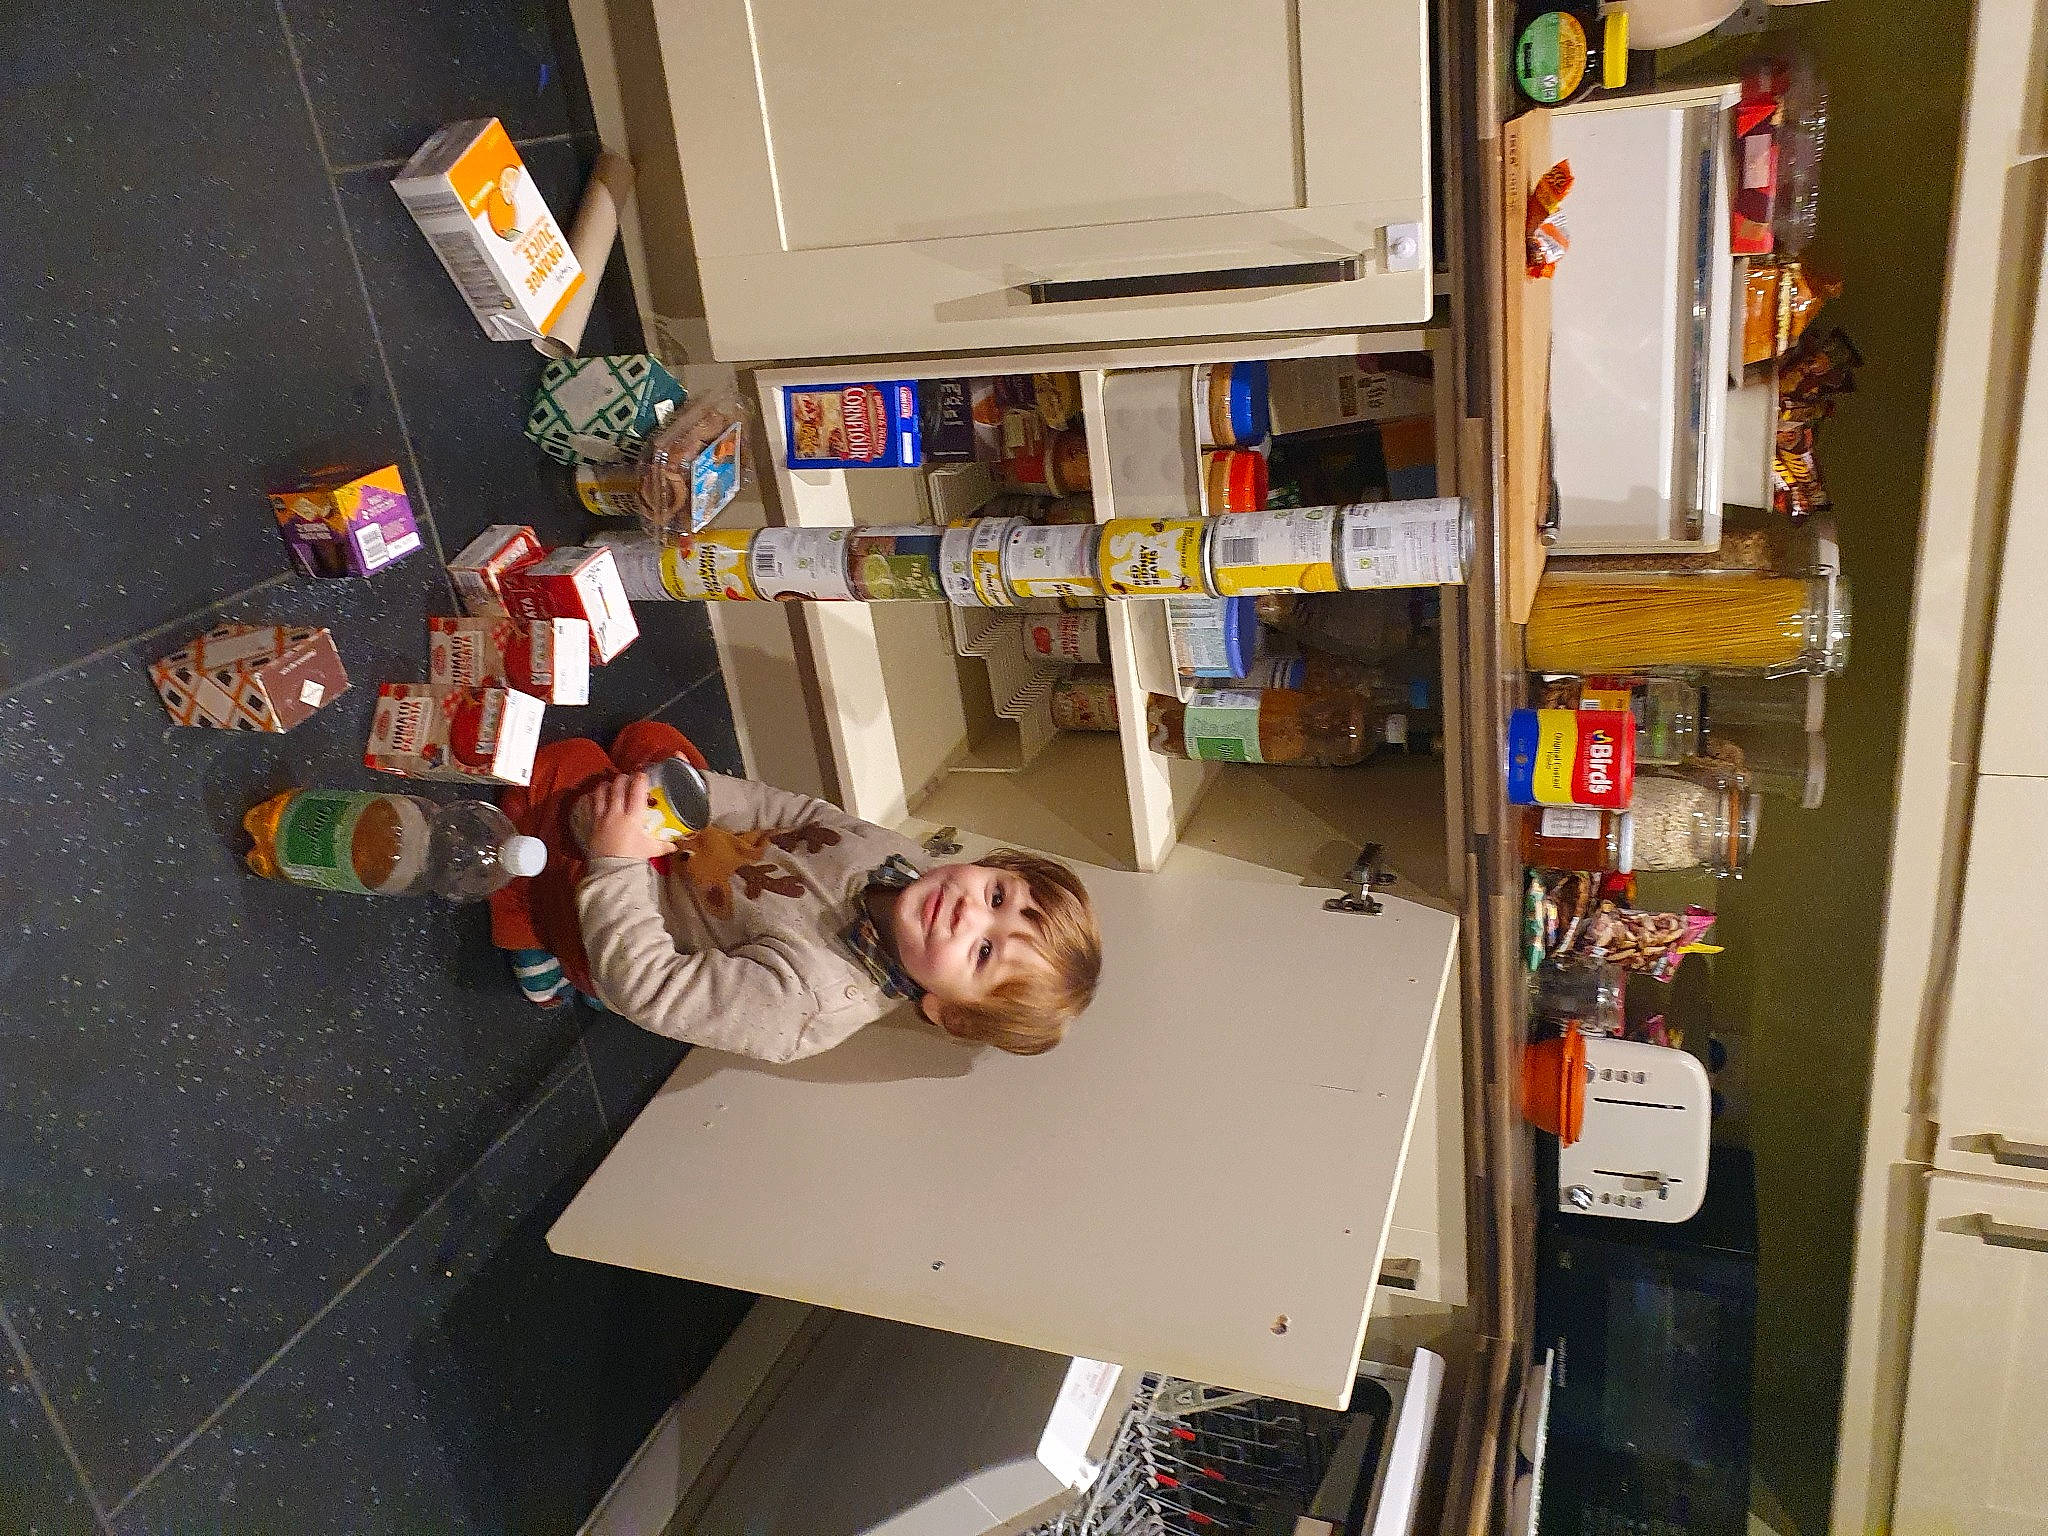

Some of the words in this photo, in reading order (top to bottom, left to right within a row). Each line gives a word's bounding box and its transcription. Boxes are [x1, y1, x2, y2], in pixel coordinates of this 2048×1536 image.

[523, 223, 555, 266] JUICE
[524, 242, 566, 297] ORANGE
[842, 386, 870, 460] CORNFLOUR
[699, 546, 718, 597] TOMATOES
[706, 544, 722, 593] CHOPPED
[1138, 544, 1151, 587] KIDNEY
[391, 702, 412, 751] TOMATO
[400, 700, 423, 753] PASSATA
